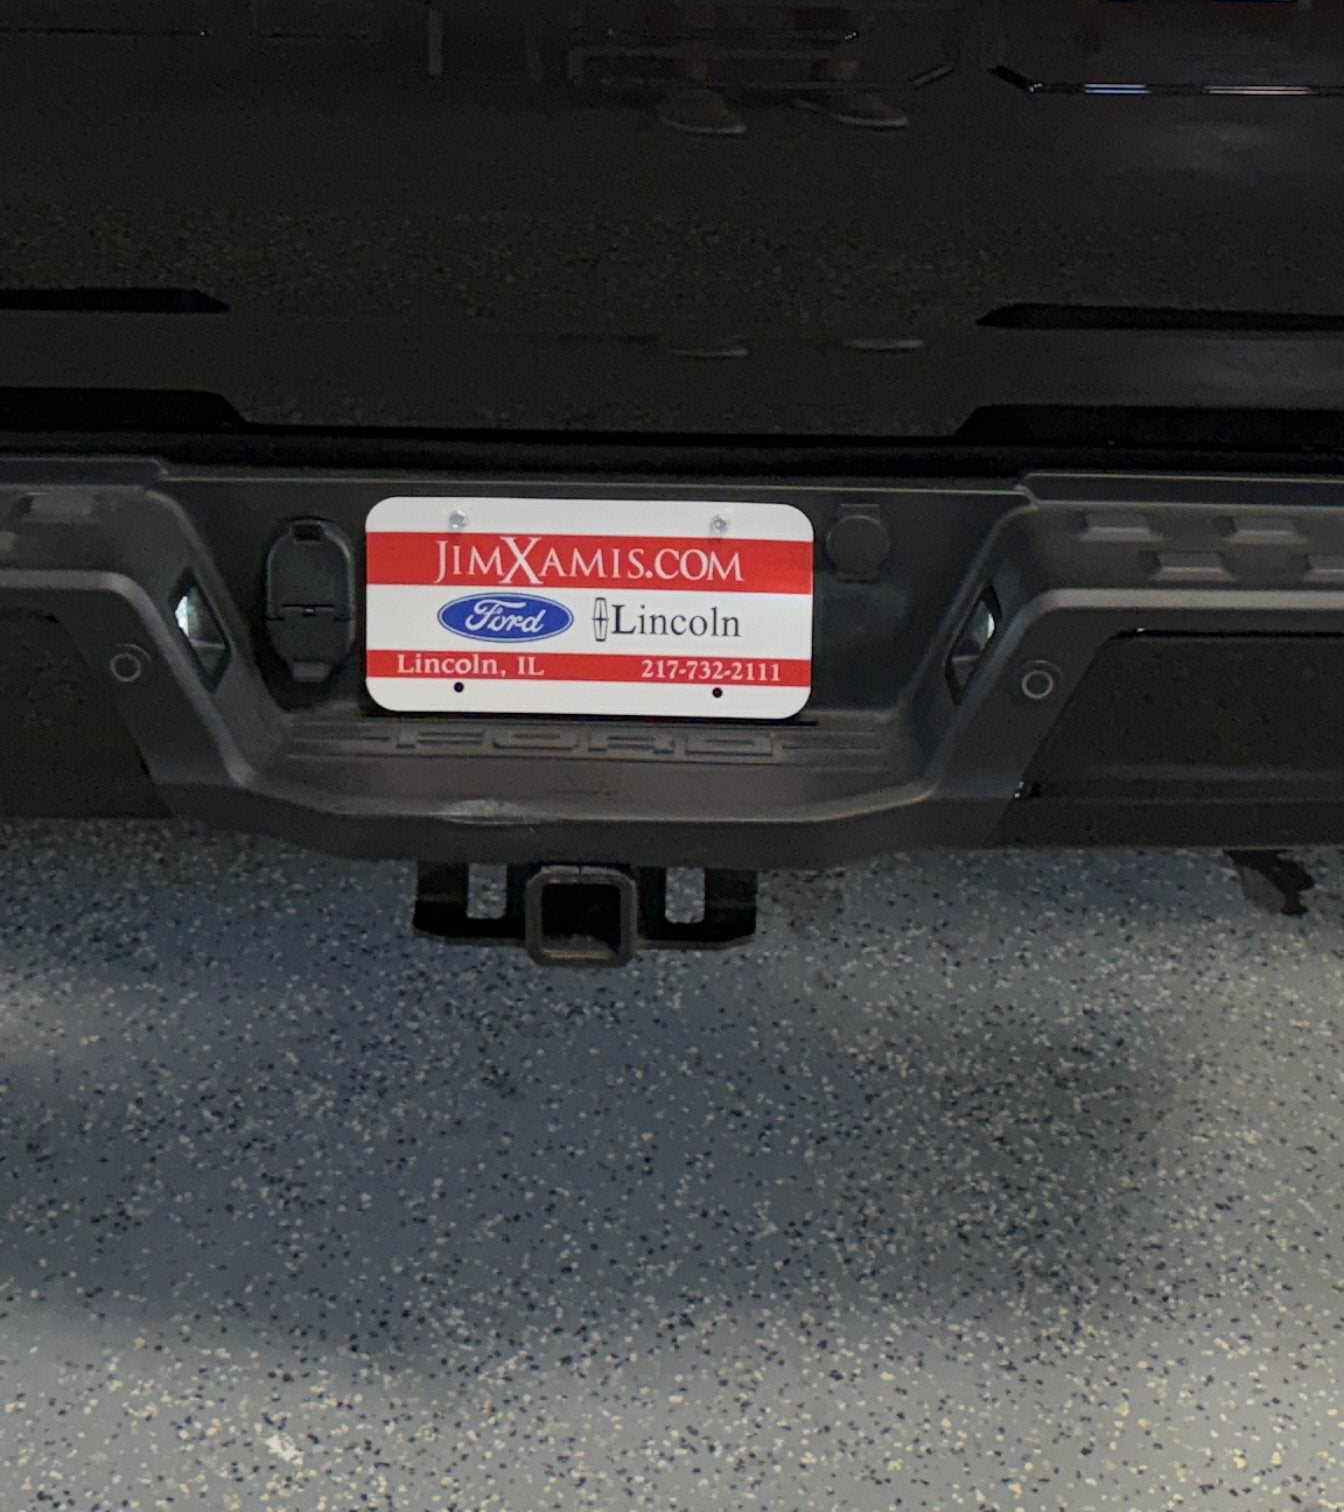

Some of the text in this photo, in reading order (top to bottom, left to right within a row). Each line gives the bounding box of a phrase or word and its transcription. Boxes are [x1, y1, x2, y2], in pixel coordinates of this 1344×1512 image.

[433, 536, 744, 585] JIMXAMIS.COM
[463, 598, 743, 638] Ford Lincoln
[396, 653, 782, 682] Lincoln, IL 217-732-2111
